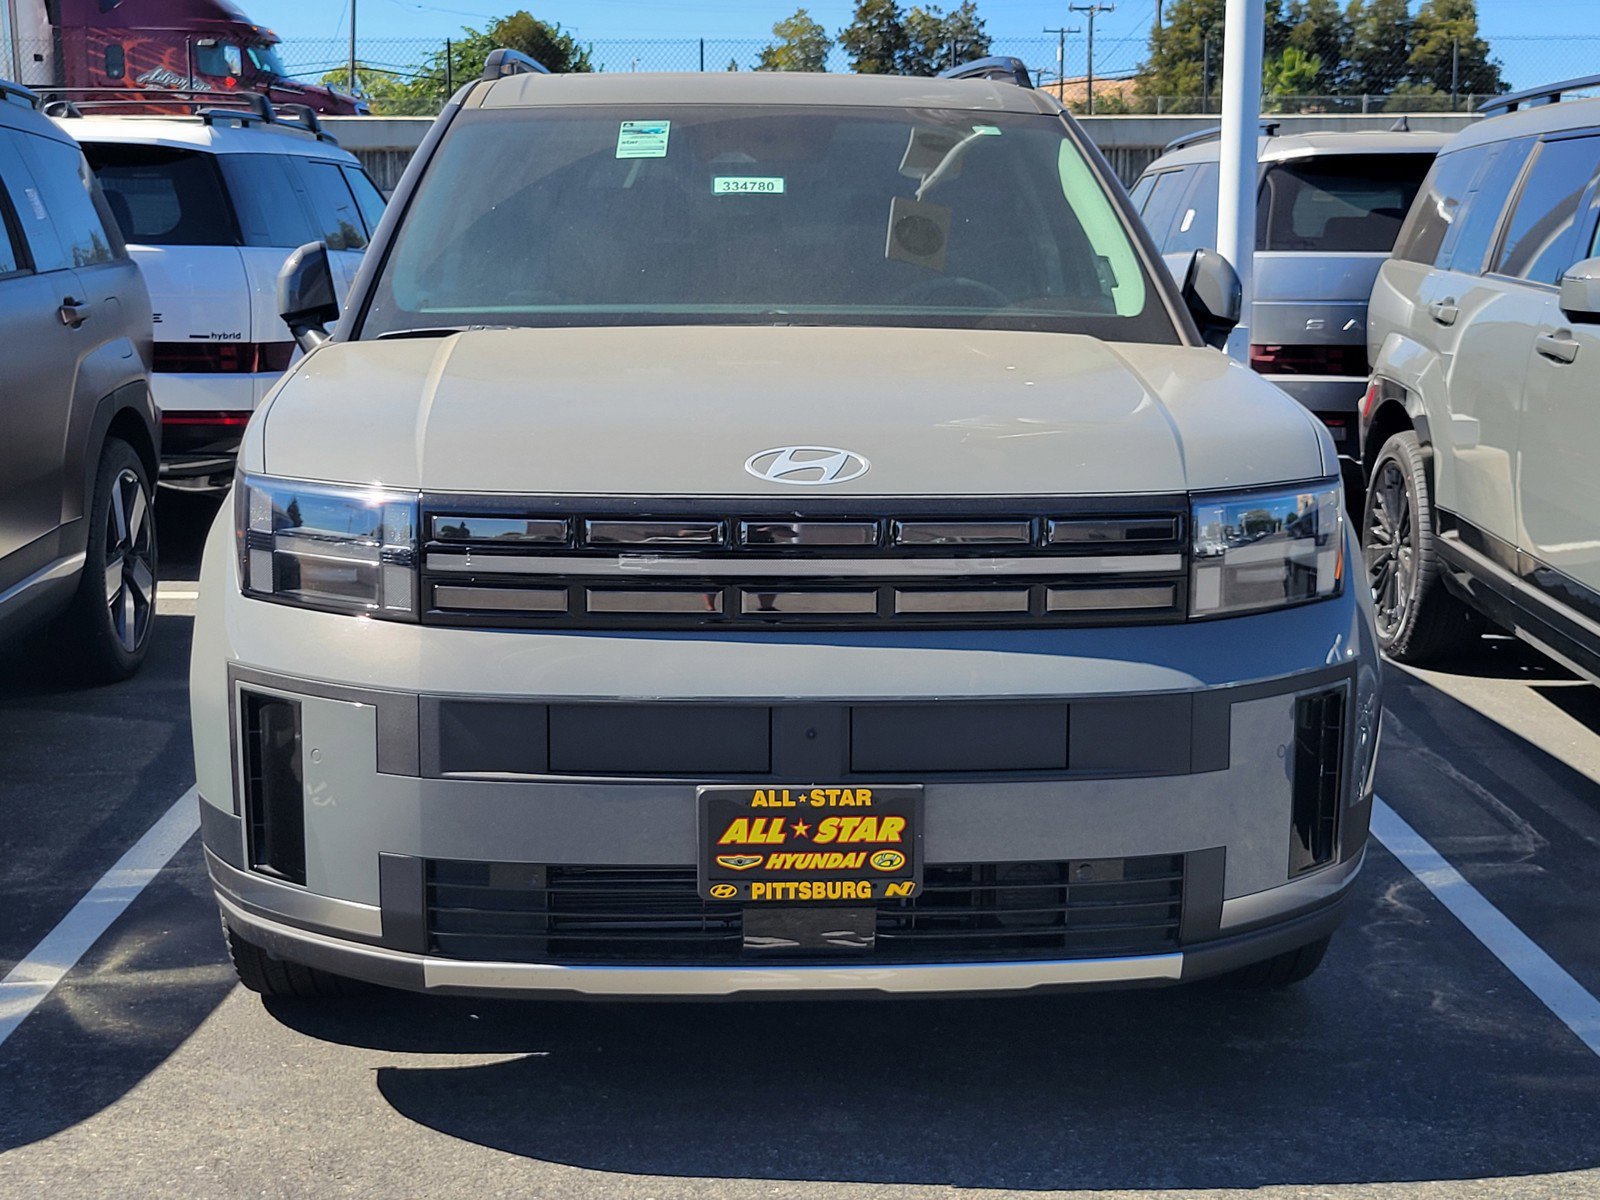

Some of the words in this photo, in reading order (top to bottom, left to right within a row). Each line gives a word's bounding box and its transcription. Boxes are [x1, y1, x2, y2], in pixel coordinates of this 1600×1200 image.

[722, 181, 775, 191] 334780
[211, 332, 242, 341] hybrid
[751, 790, 796, 807] ALL
[810, 789, 872, 807] STAR
[717, 816, 788, 845] ALL
[811, 815, 906, 844] STAR
[764, 851, 868, 870] HYUNDAI
[751, 881, 872, 900] PITTSBURG
